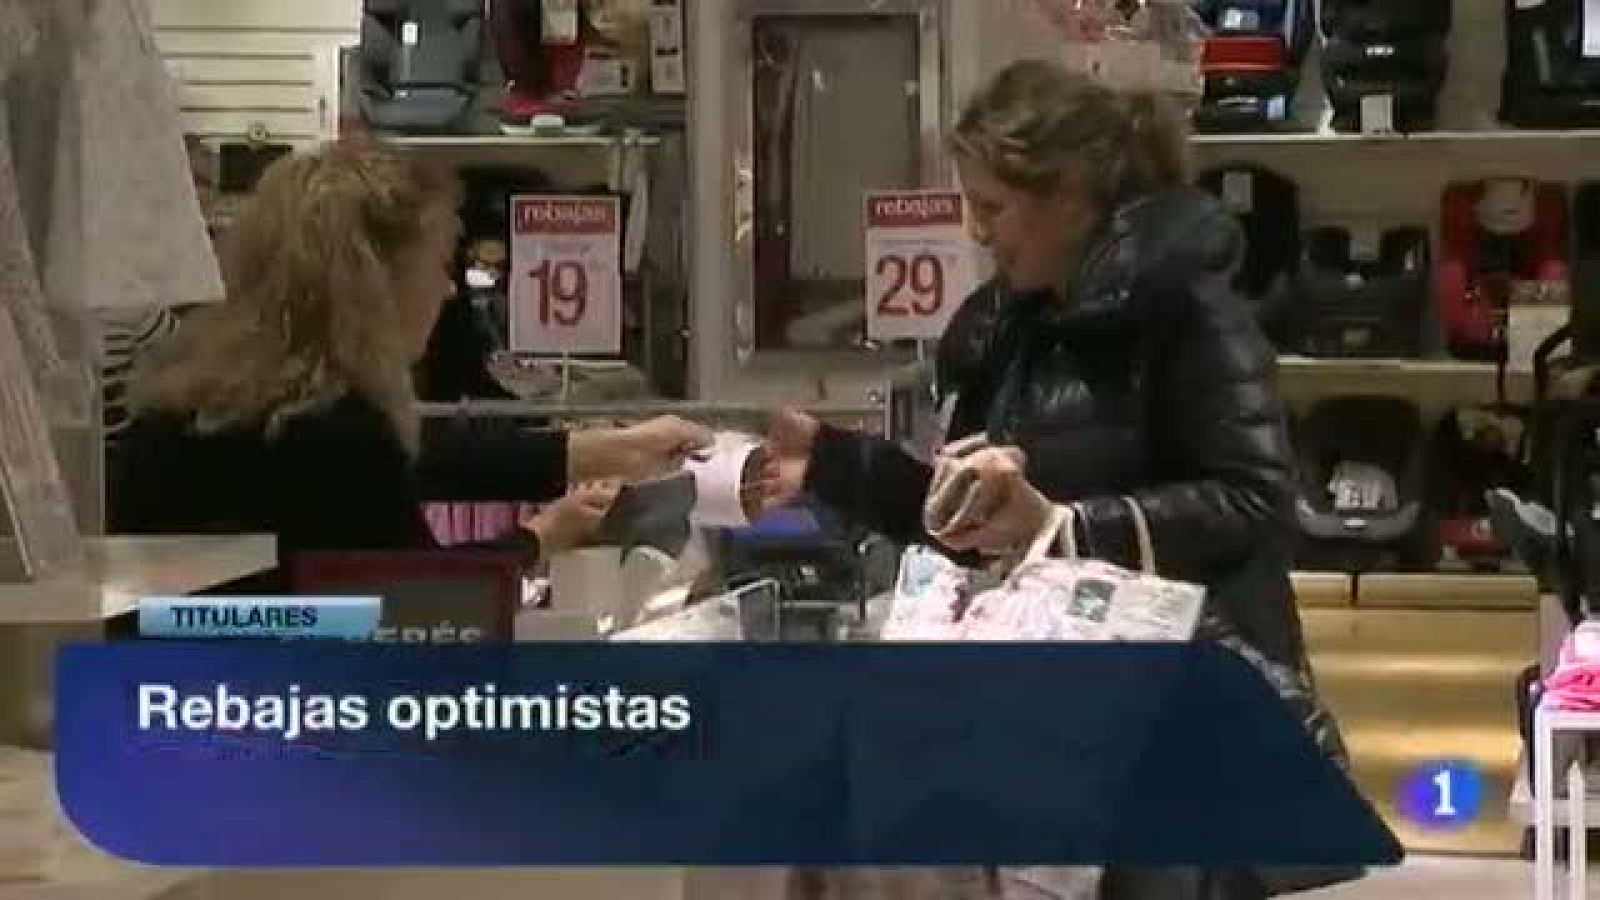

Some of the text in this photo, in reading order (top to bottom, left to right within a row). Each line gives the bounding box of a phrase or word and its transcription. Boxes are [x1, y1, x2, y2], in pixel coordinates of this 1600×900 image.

[522, 201, 608, 227] rebajas
[874, 197, 956, 219] rebajas
[527, 259, 588, 327] 19
[876, 254, 944, 317] 29
